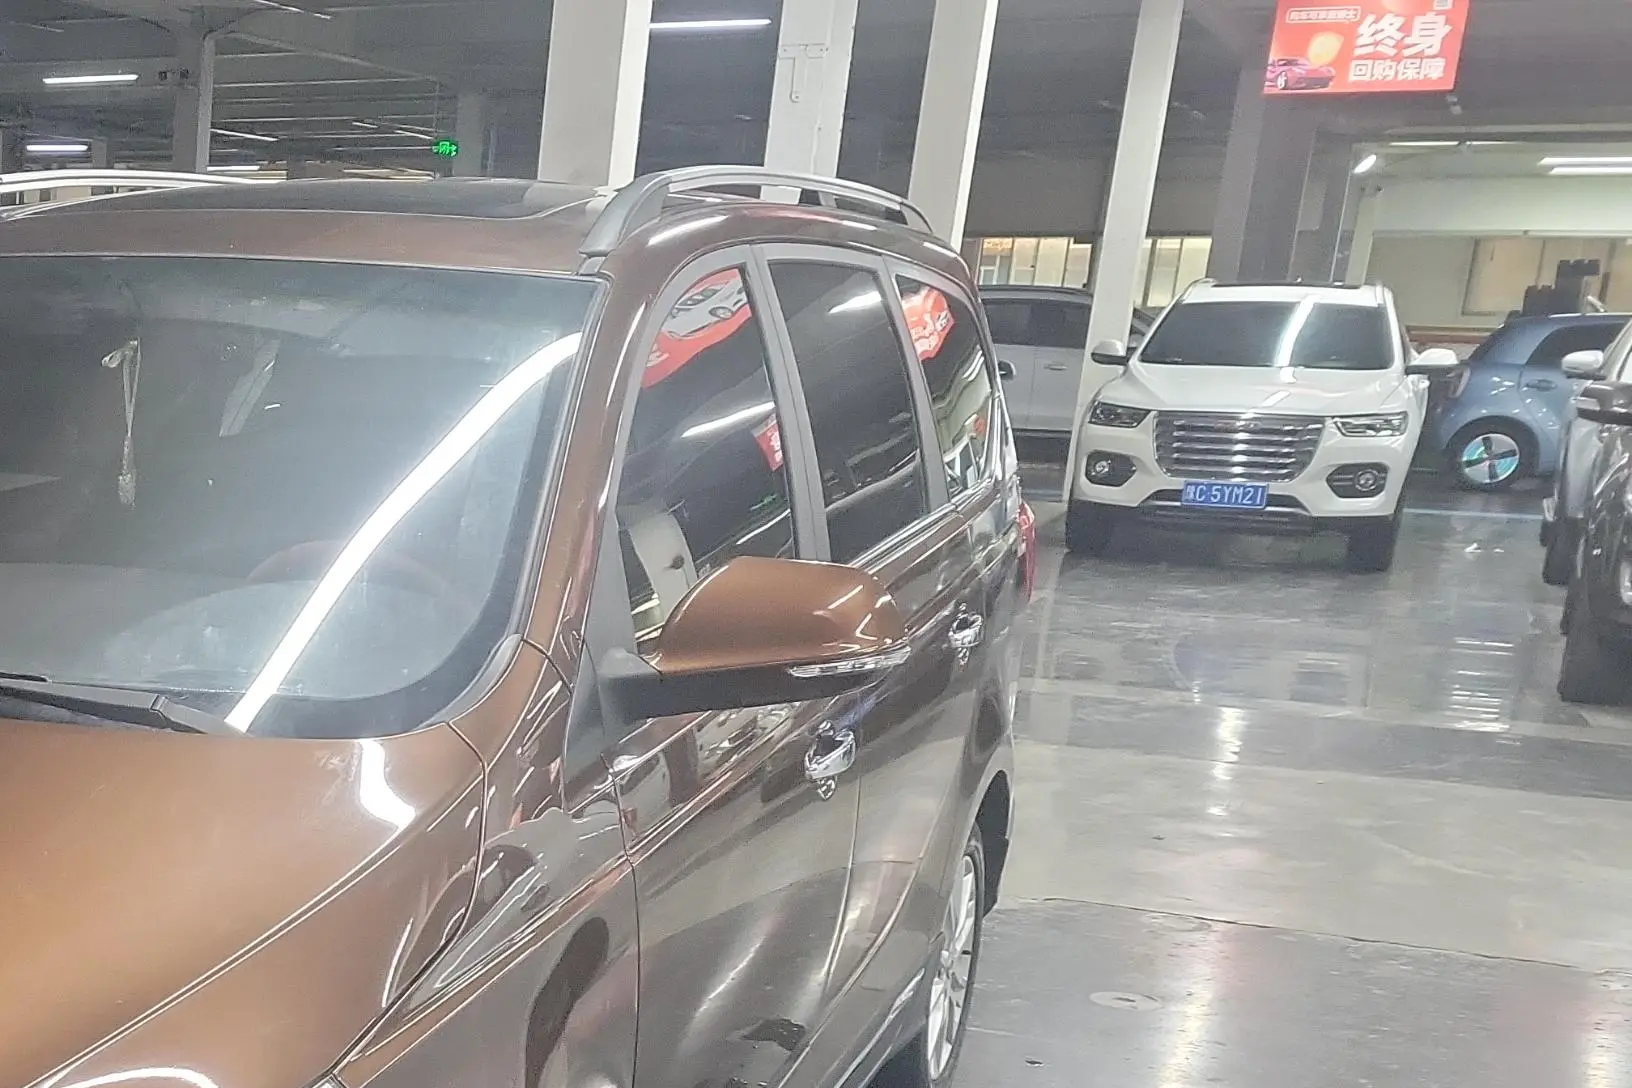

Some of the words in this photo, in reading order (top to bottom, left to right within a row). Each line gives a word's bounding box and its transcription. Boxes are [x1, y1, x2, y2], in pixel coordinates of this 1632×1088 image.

[1353, 12, 1452, 57] 终身
[1348, 58, 1447, 83] 回购保障
